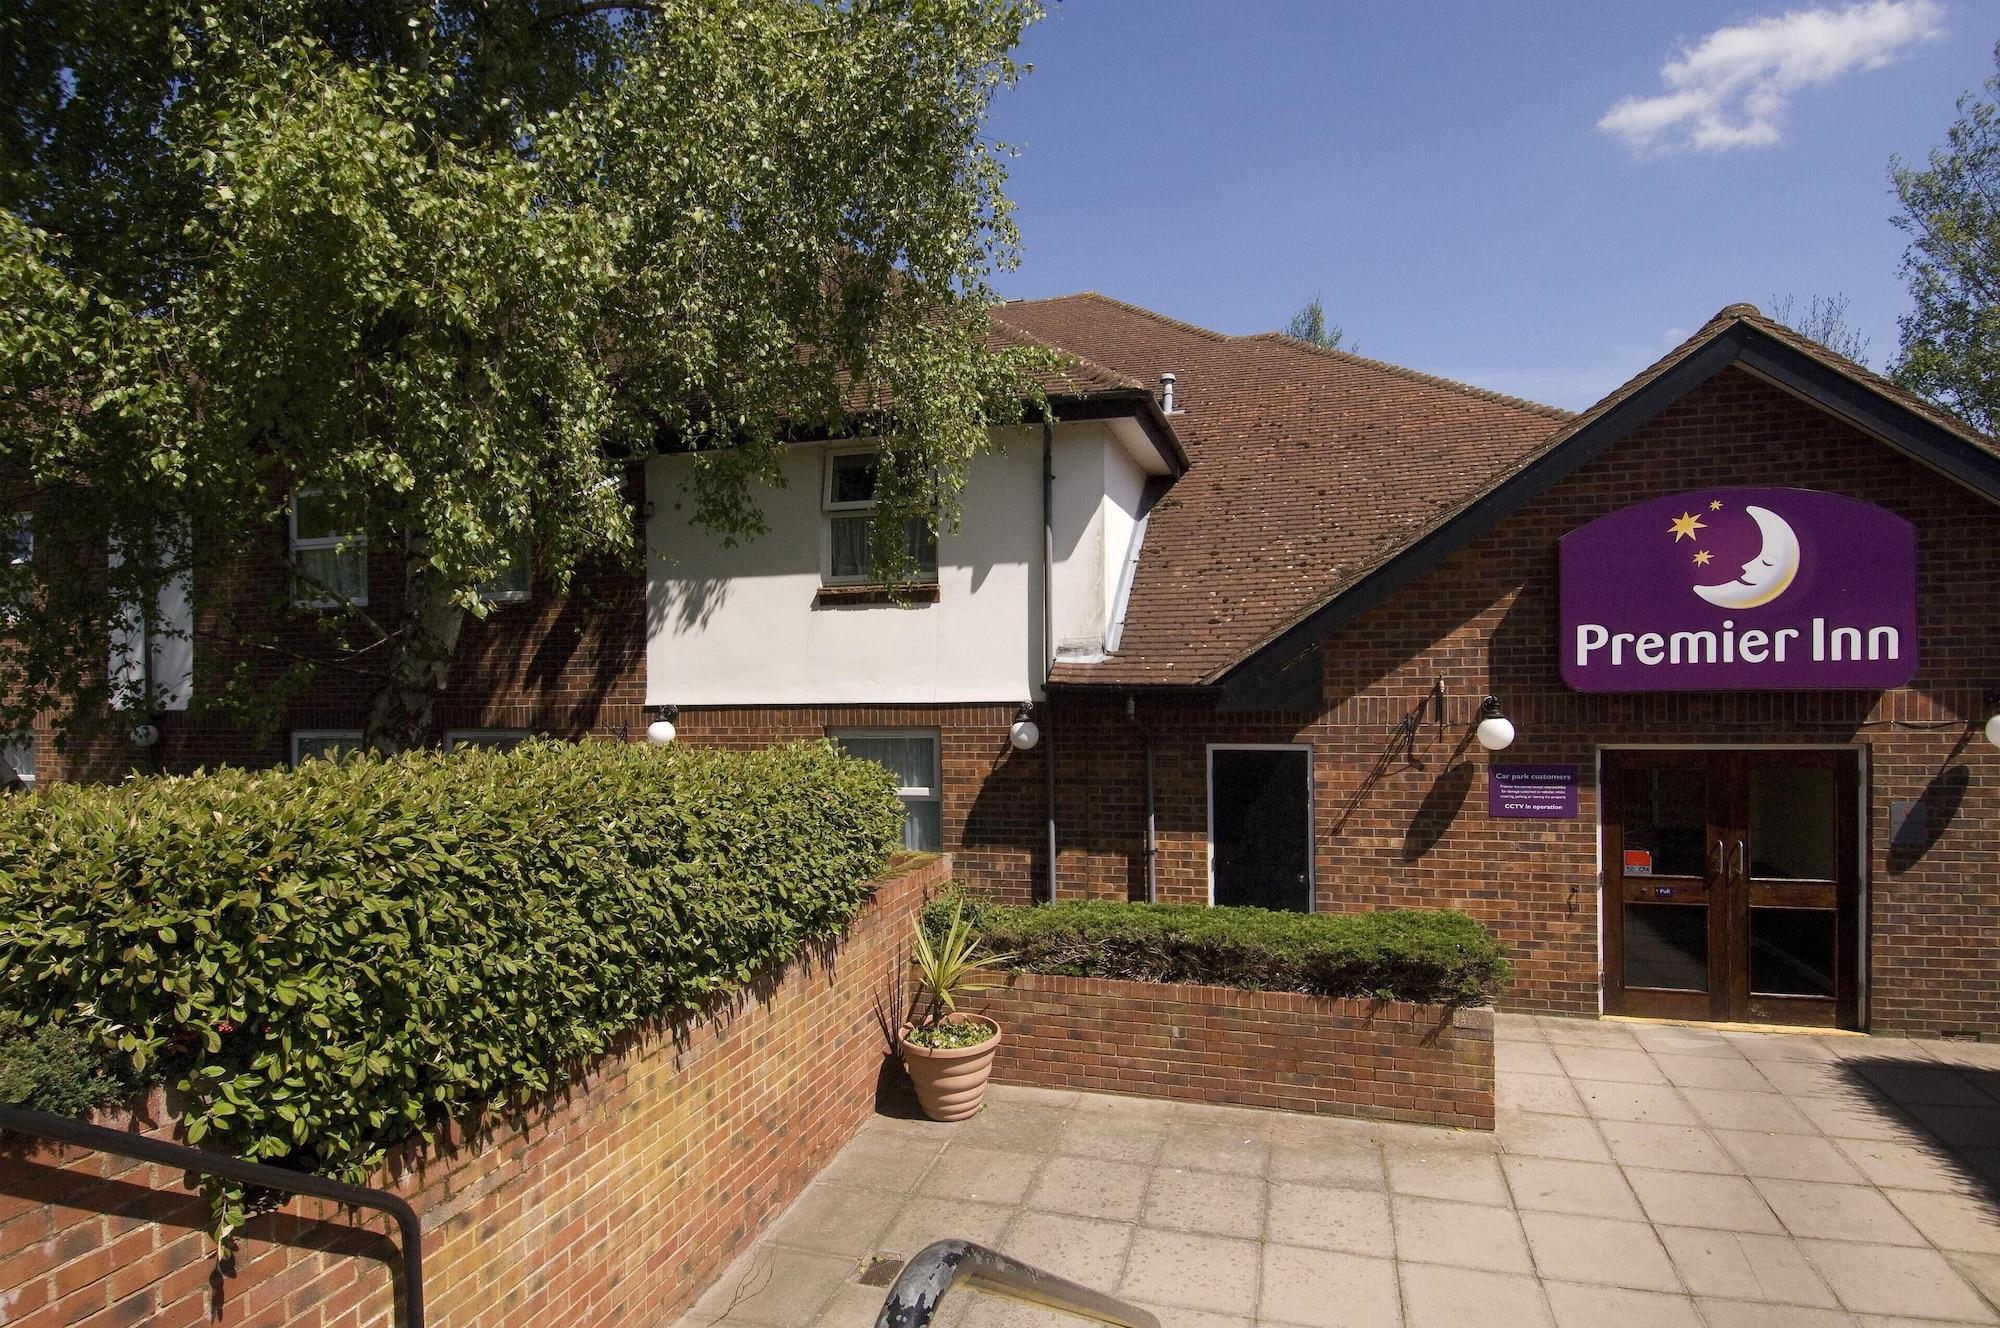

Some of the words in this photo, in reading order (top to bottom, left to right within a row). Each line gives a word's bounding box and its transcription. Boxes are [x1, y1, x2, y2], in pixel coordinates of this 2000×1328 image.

[1576, 619, 1799, 667] Premier
[1812, 617, 1899, 662] Inn
[1511, 773, 1530, 781] park
